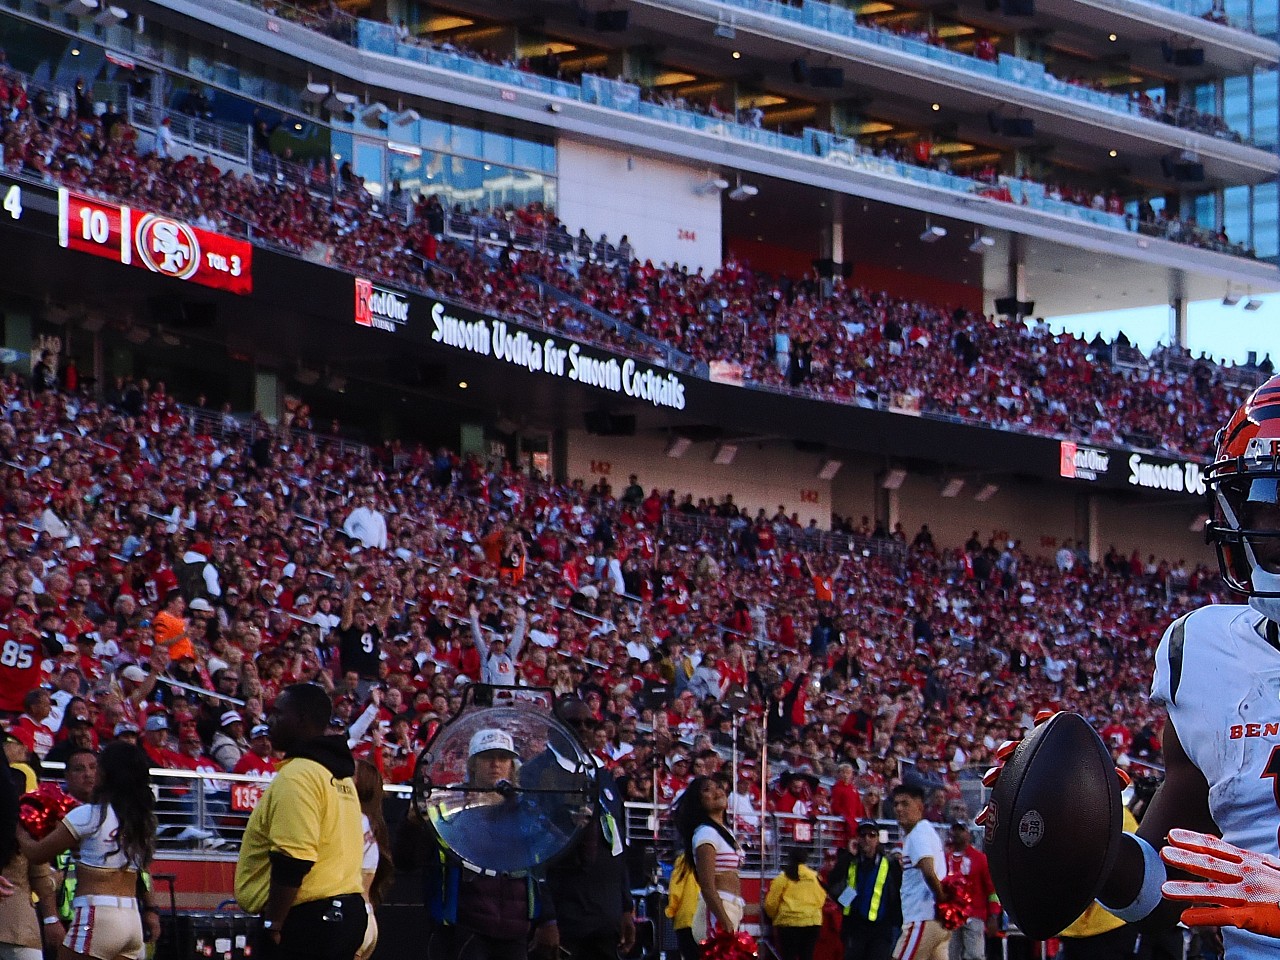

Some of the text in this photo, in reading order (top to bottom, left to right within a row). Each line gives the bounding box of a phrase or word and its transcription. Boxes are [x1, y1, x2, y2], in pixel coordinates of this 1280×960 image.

[4, 185, 22, 219] 4
[80, 207, 109, 243] 10
[230, 255, 242, 277] 3
[431, 302, 686, 410] Smooth Vodka for Smooth Cocktails
[1, 640, 34, 669] 85
[361, 632, 374, 653] 9
[234, 785, 259, 809] 135
